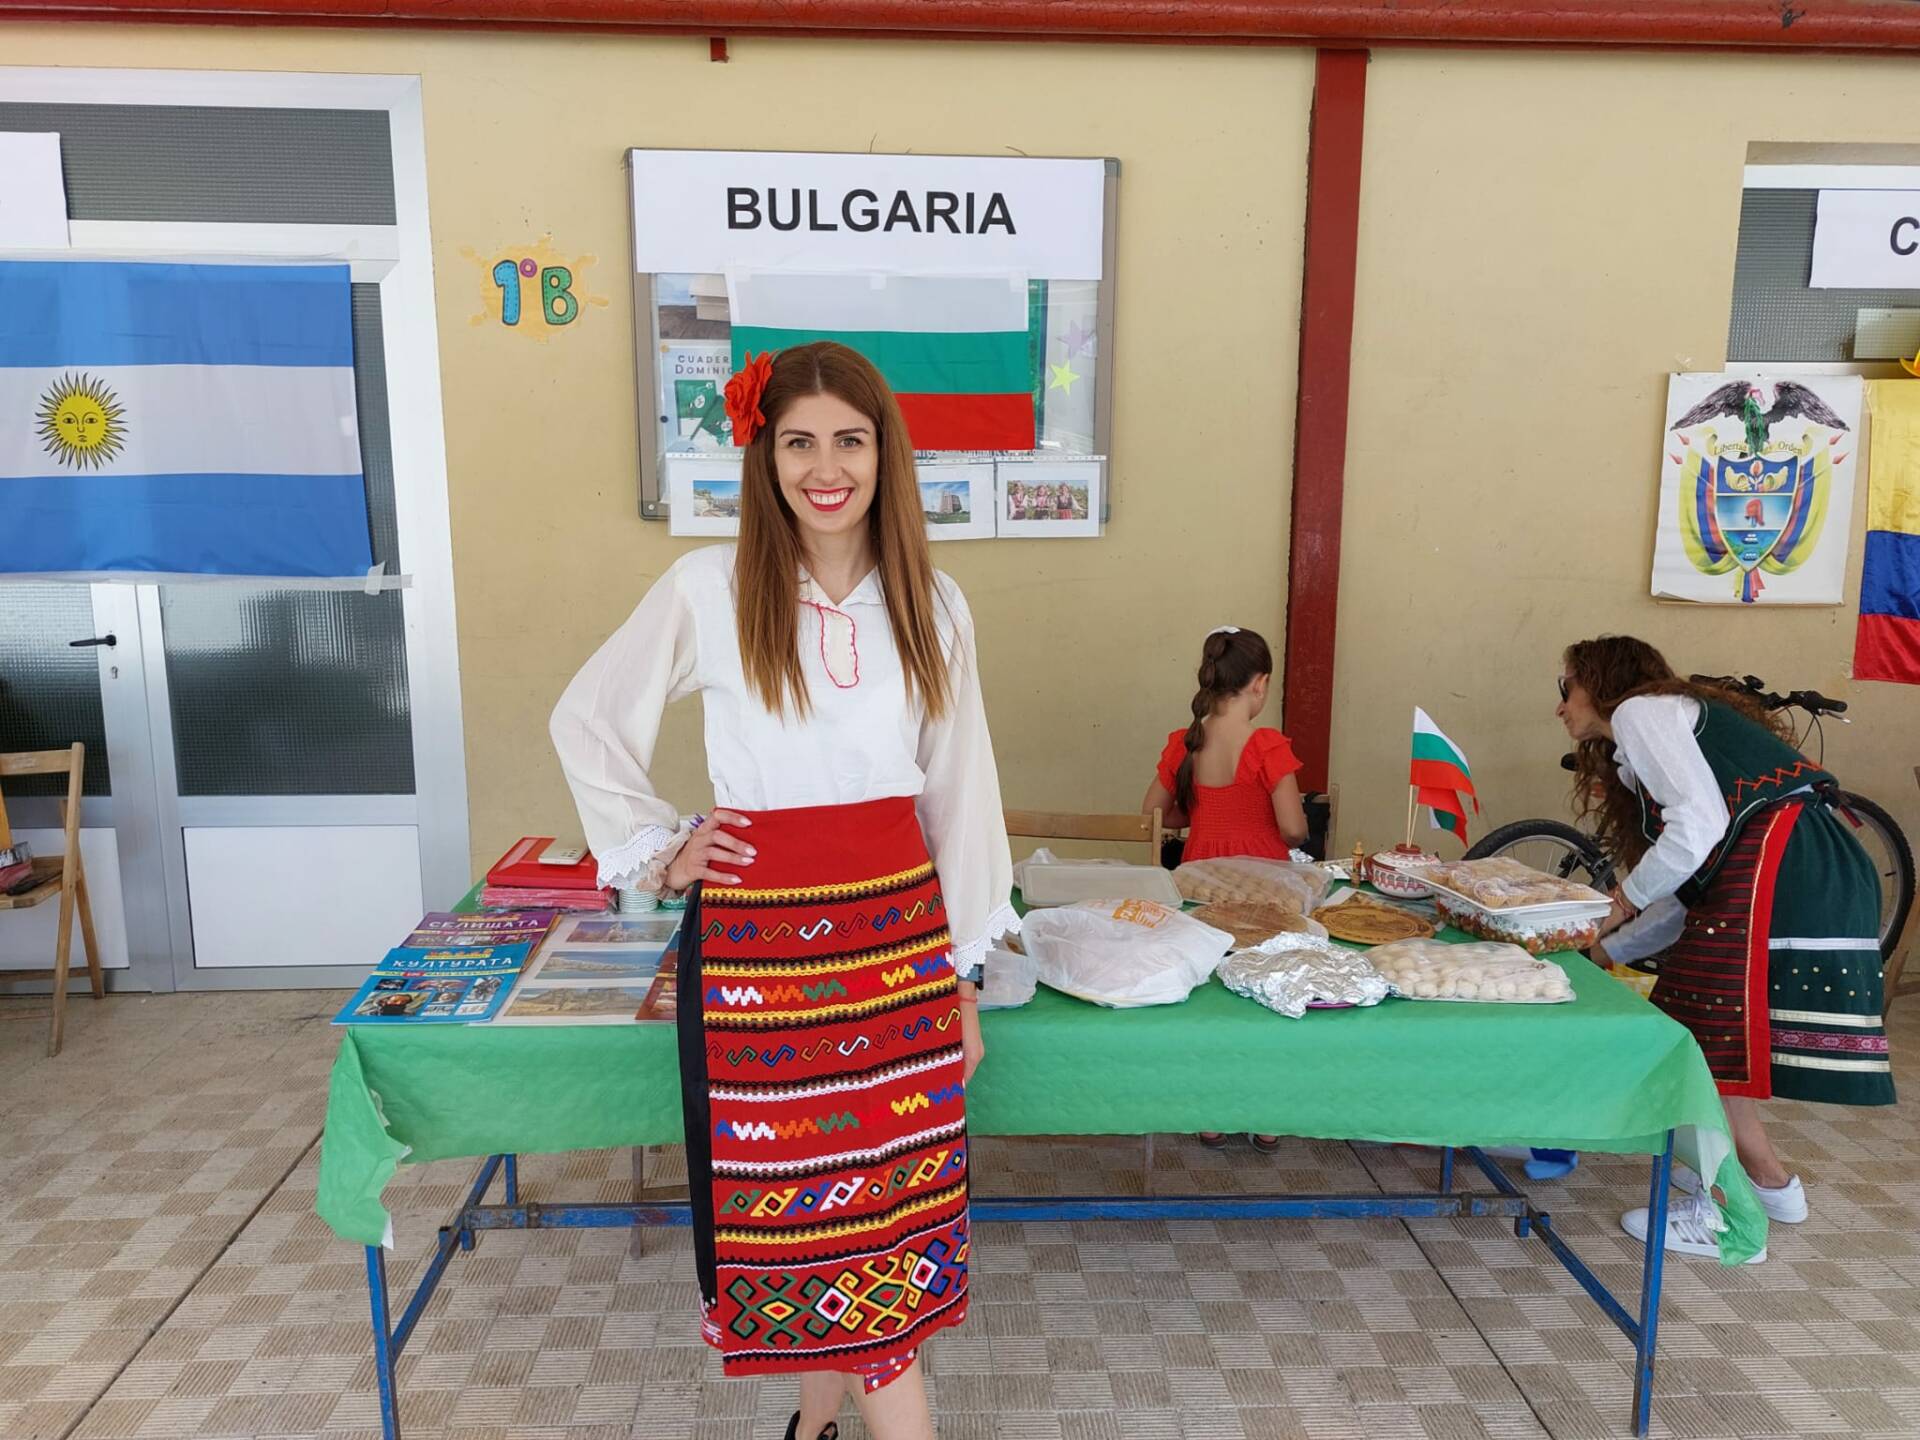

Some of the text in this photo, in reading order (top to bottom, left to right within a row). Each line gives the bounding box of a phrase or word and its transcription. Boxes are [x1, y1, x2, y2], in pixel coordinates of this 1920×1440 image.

[727, 187, 1017, 235] BULGARIA
[677, 355, 729, 364] CUADER
[392, 957, 513, 968] КУЛТУРАТА
